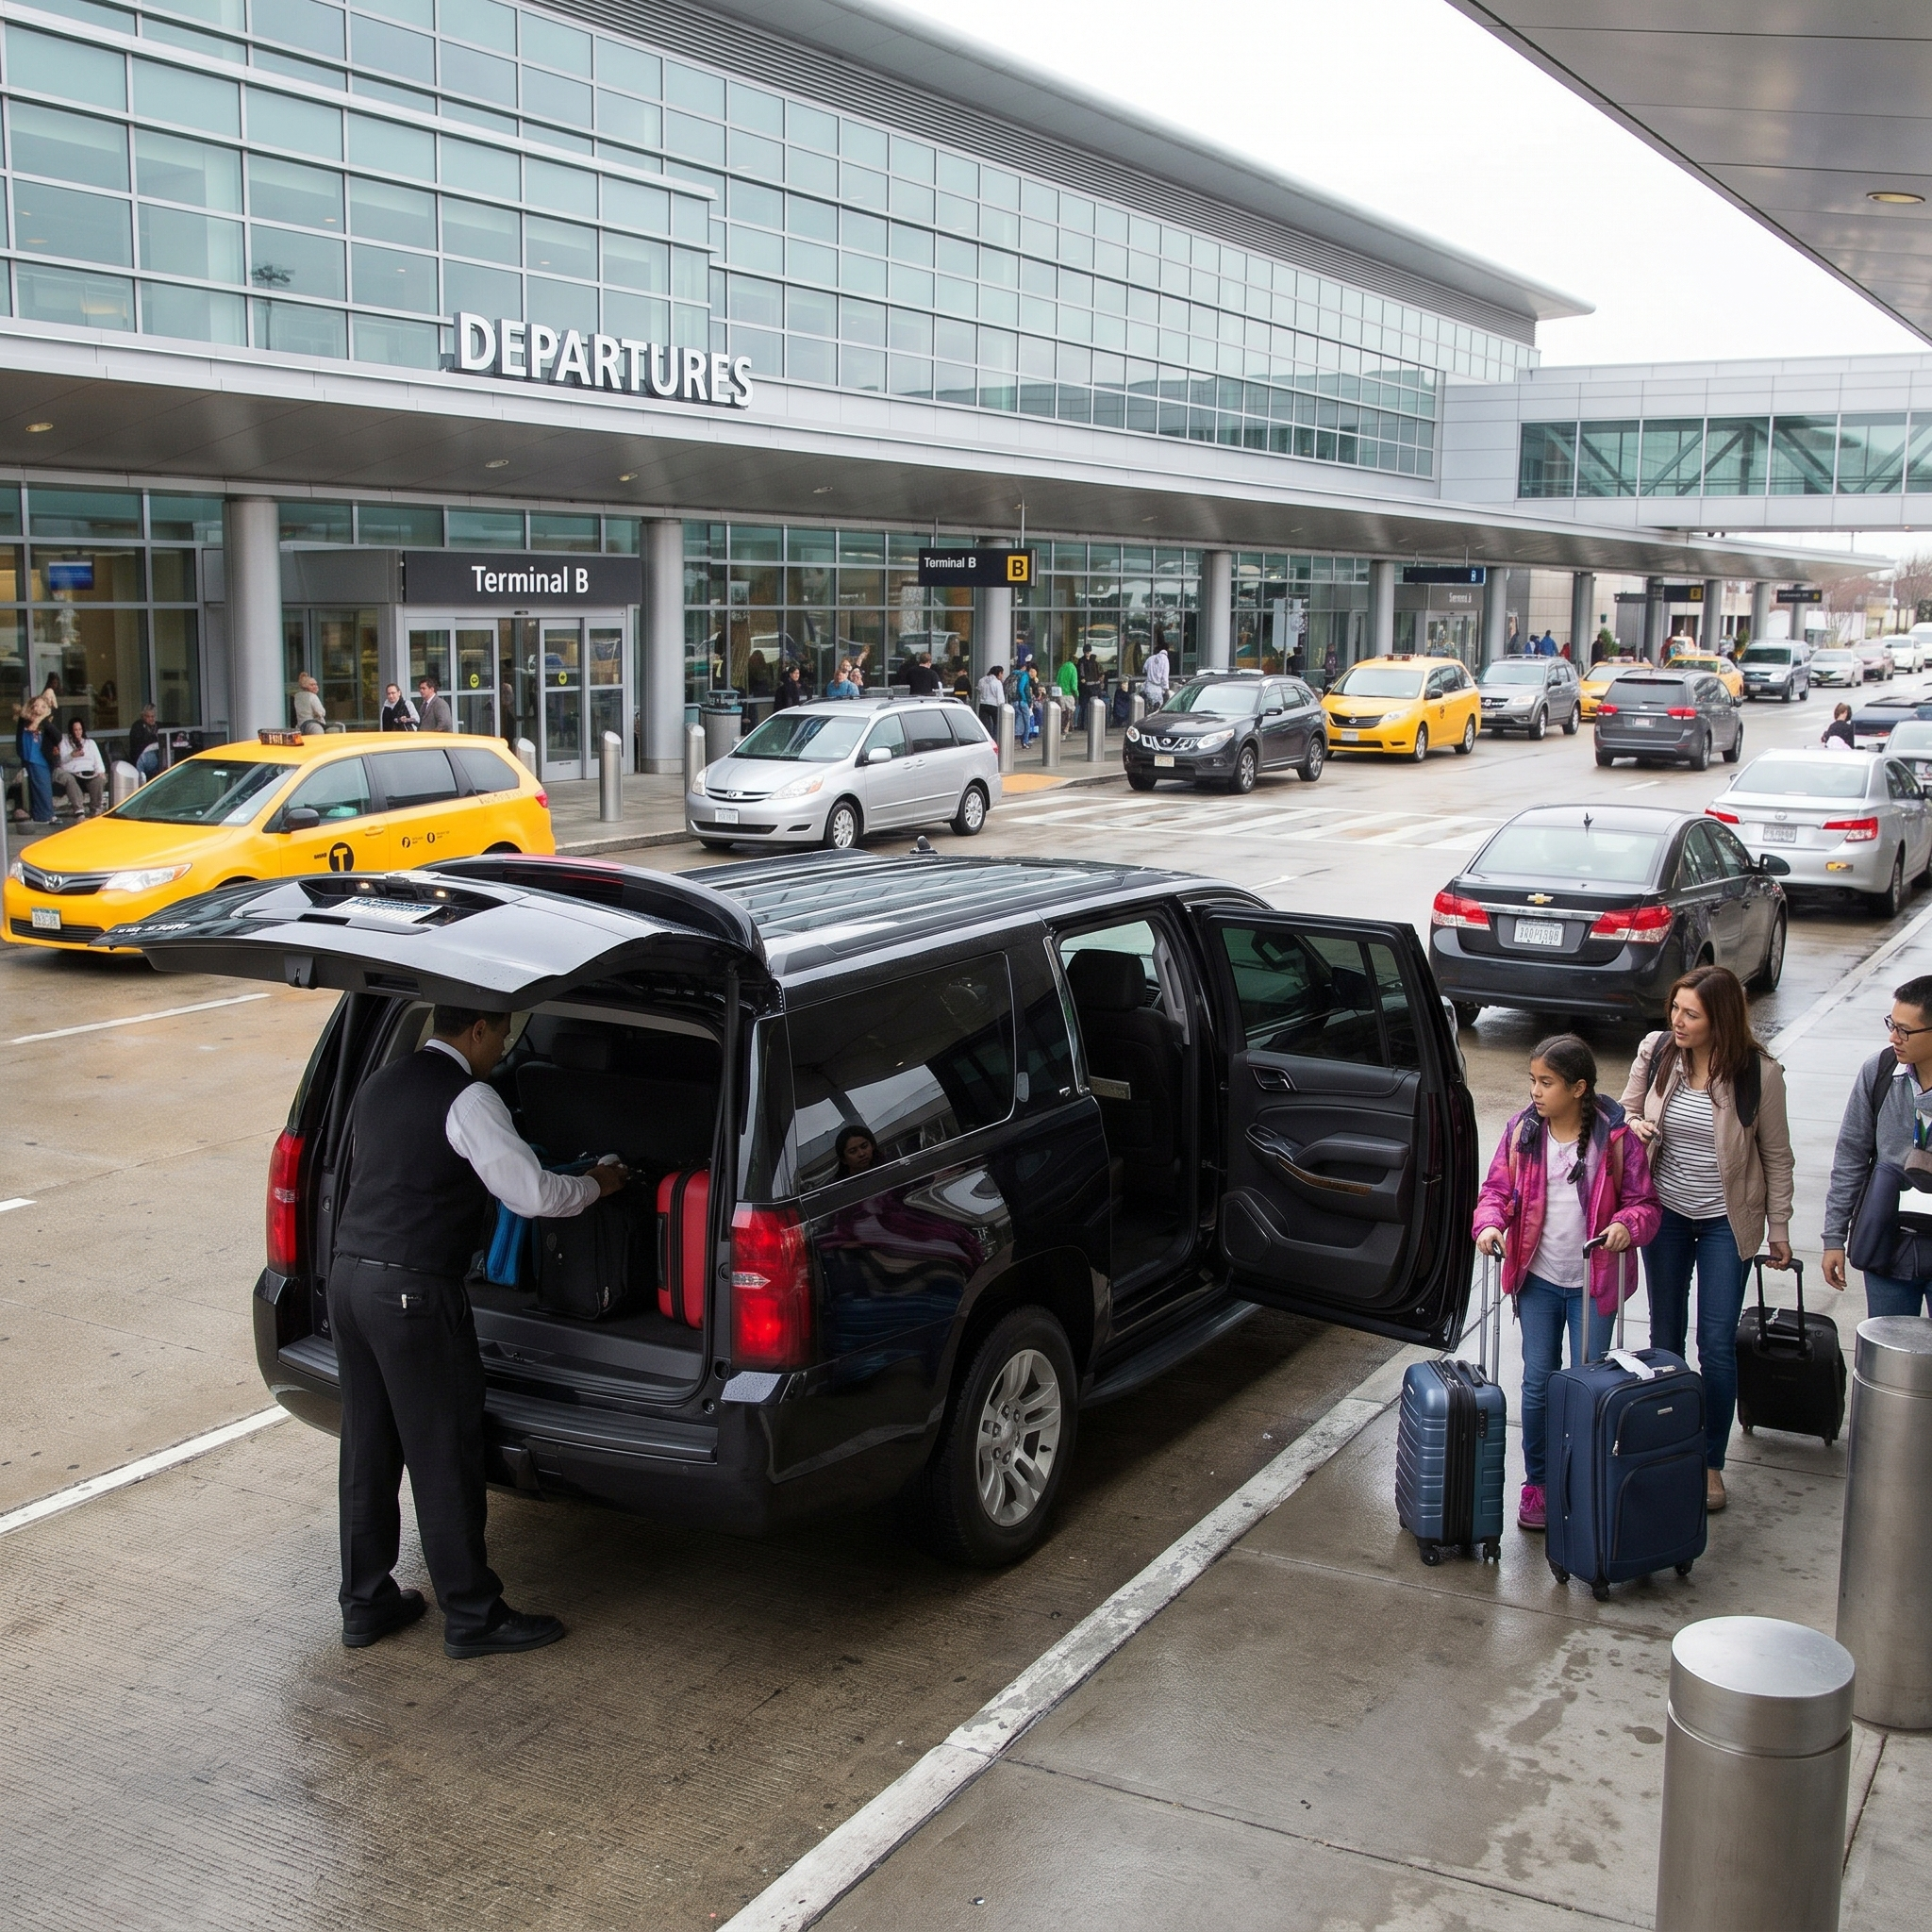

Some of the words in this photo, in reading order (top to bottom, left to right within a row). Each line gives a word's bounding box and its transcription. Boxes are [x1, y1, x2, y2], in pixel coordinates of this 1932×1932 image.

[458, 311, 754, 407] DEPARTURES
[924, 557, 965, 568] Terminal
[968, 557, 976, 568] B
[1011, 559, 1024, 577] B
[471, 566, 568, 593] Terminal
[575, 568, 590, 593] B
